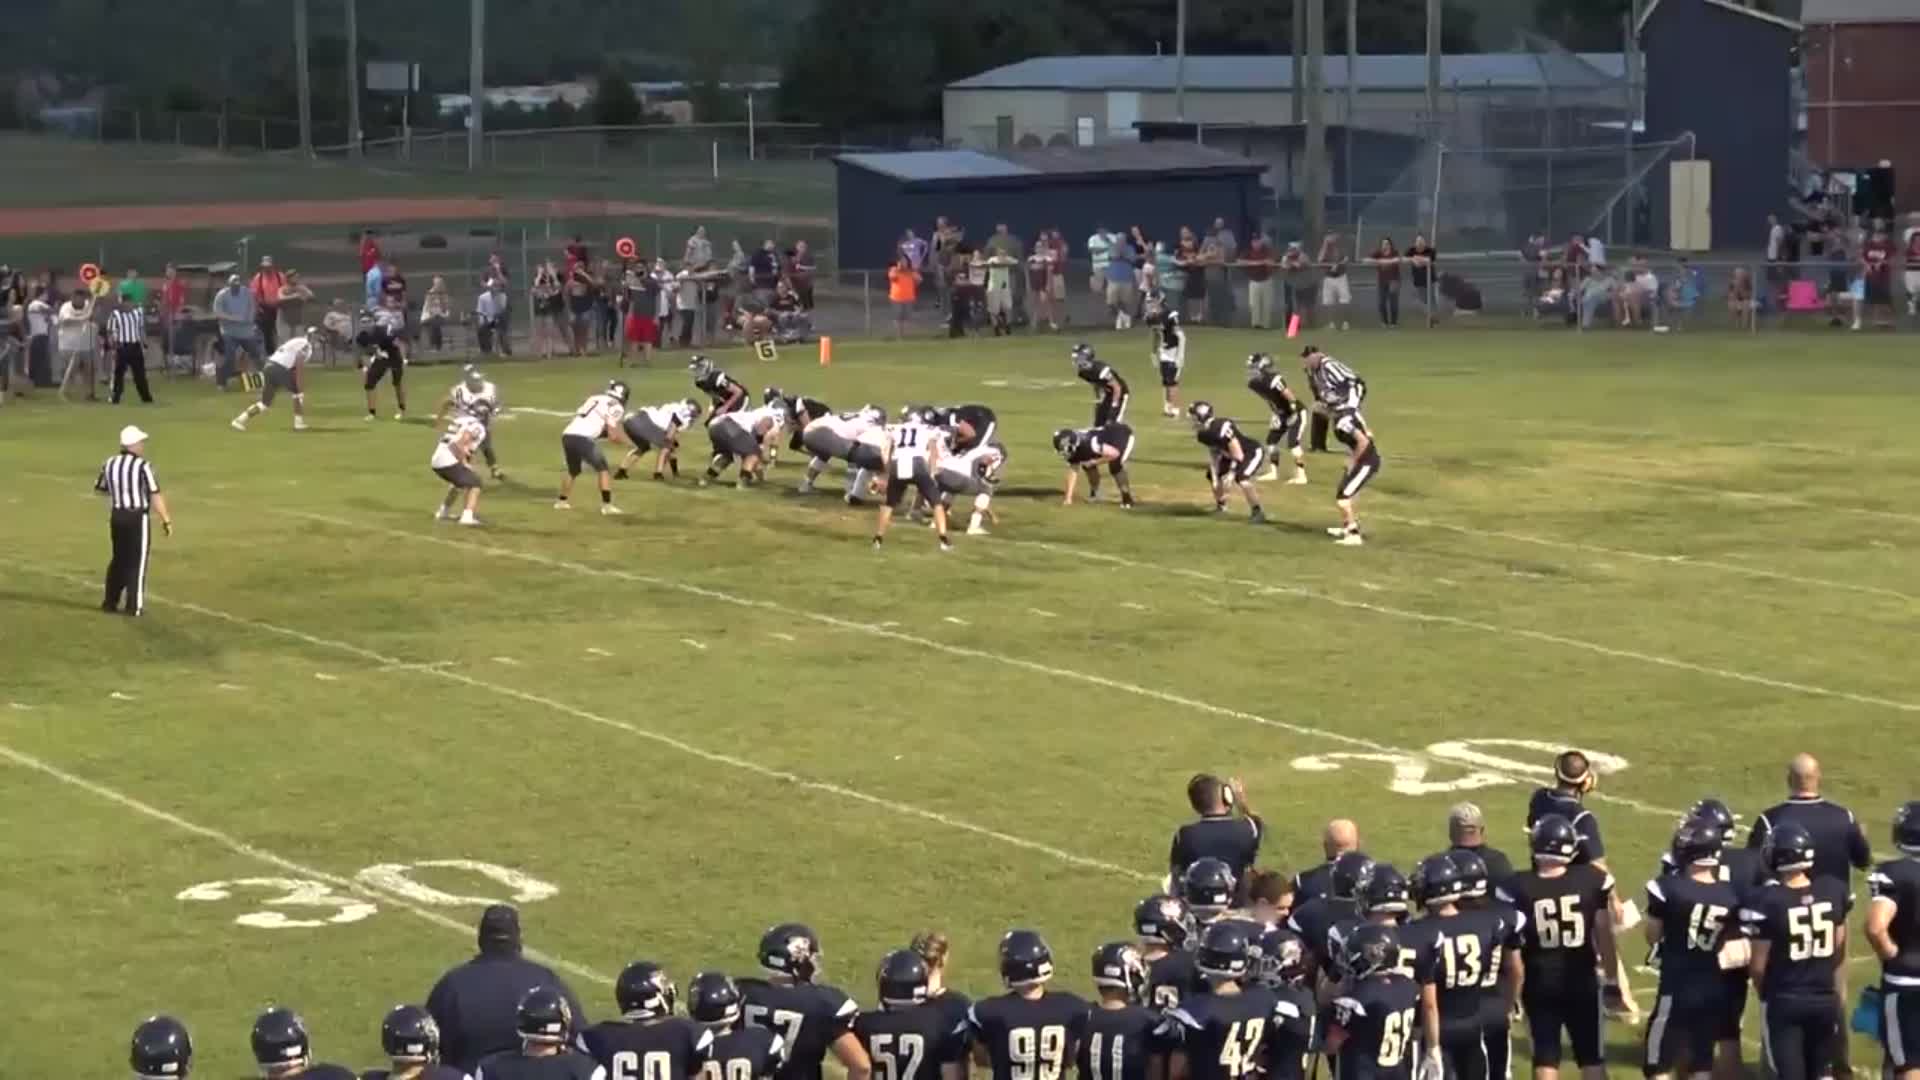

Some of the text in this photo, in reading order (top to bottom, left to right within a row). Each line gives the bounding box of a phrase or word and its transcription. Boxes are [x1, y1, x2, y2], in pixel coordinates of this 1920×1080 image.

[760, 342, 775, 359] G
[897, 427, 917, 448] 11
[1290, 738, 1629, 795] 20
[176, 858, 559, 928] 30
[1533, 894, 1585, 949] 65
[1687, 903, 1729, 952] 15
[1787, 902, 1835, 962] 55
[1441, 933, 1482, 988] 13
[870, 1033, 924, 1080] 52
[1008, 1025, 1066, 1080] 99
[1219, 1017, 1266, 1077] 42
